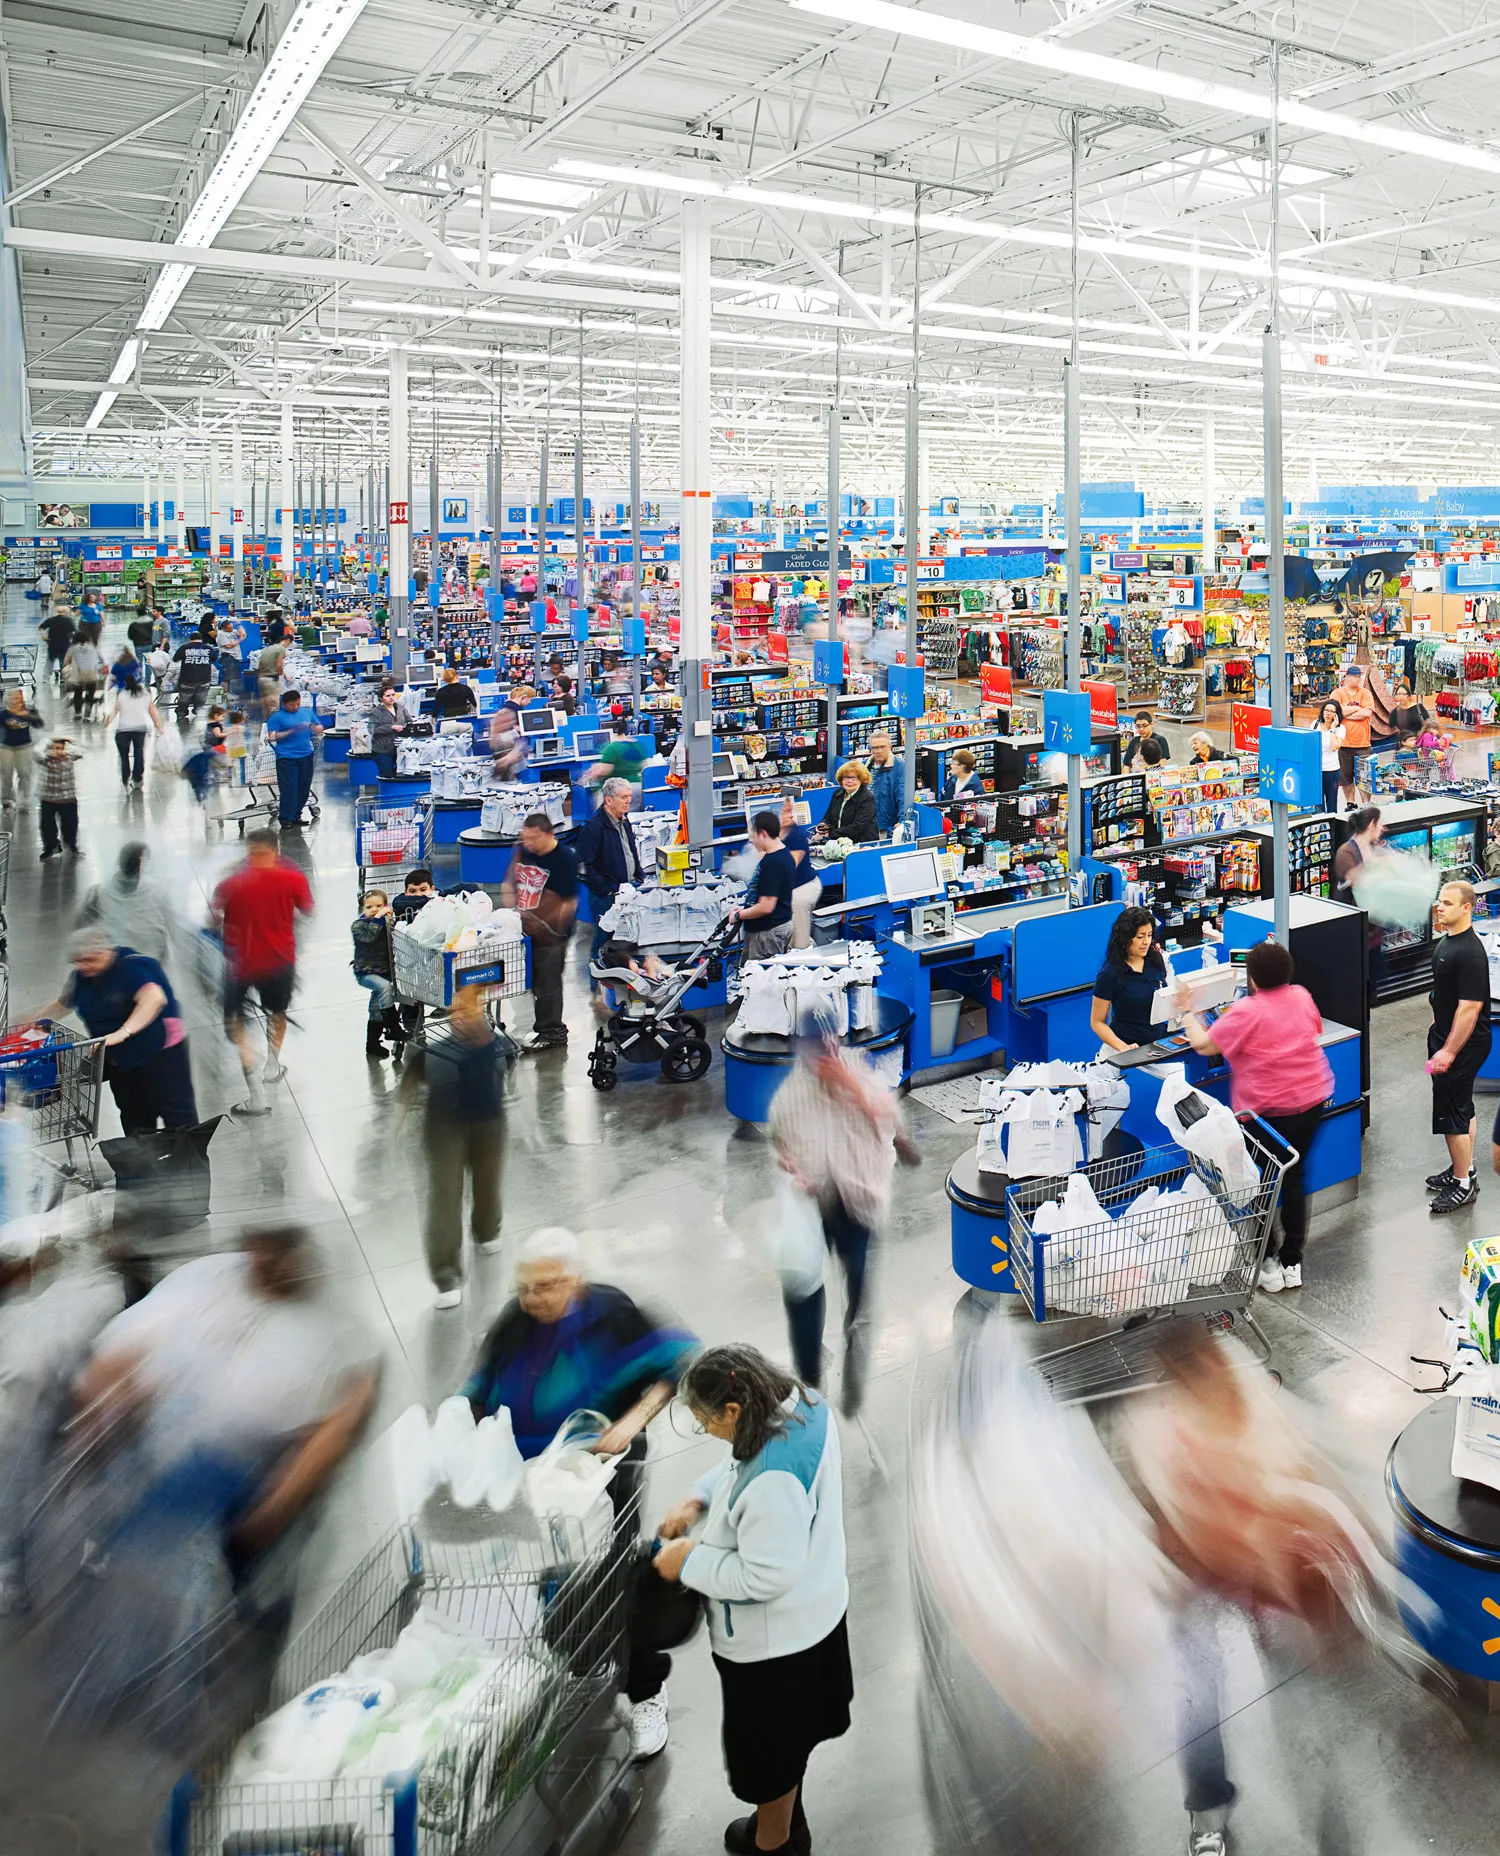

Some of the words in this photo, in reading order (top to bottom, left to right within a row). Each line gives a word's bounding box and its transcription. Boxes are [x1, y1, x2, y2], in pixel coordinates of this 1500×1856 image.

[1446, 501, 1464, 513] Baby
[785, 560, 810, 568] FADED
[1369, 571, 1382, 586] $7
[891, 690, 899, 708] 8
[987, 689, 1012, 699] Unbeatable
[1090, 709, 1116, 719] nbeatable
[1050, 720, 1058, 742] 7
[1282, 767, 1295, 794] 6
[387, 809, 406, 818] Coke
[465, 971, 488, 982] Walmart
